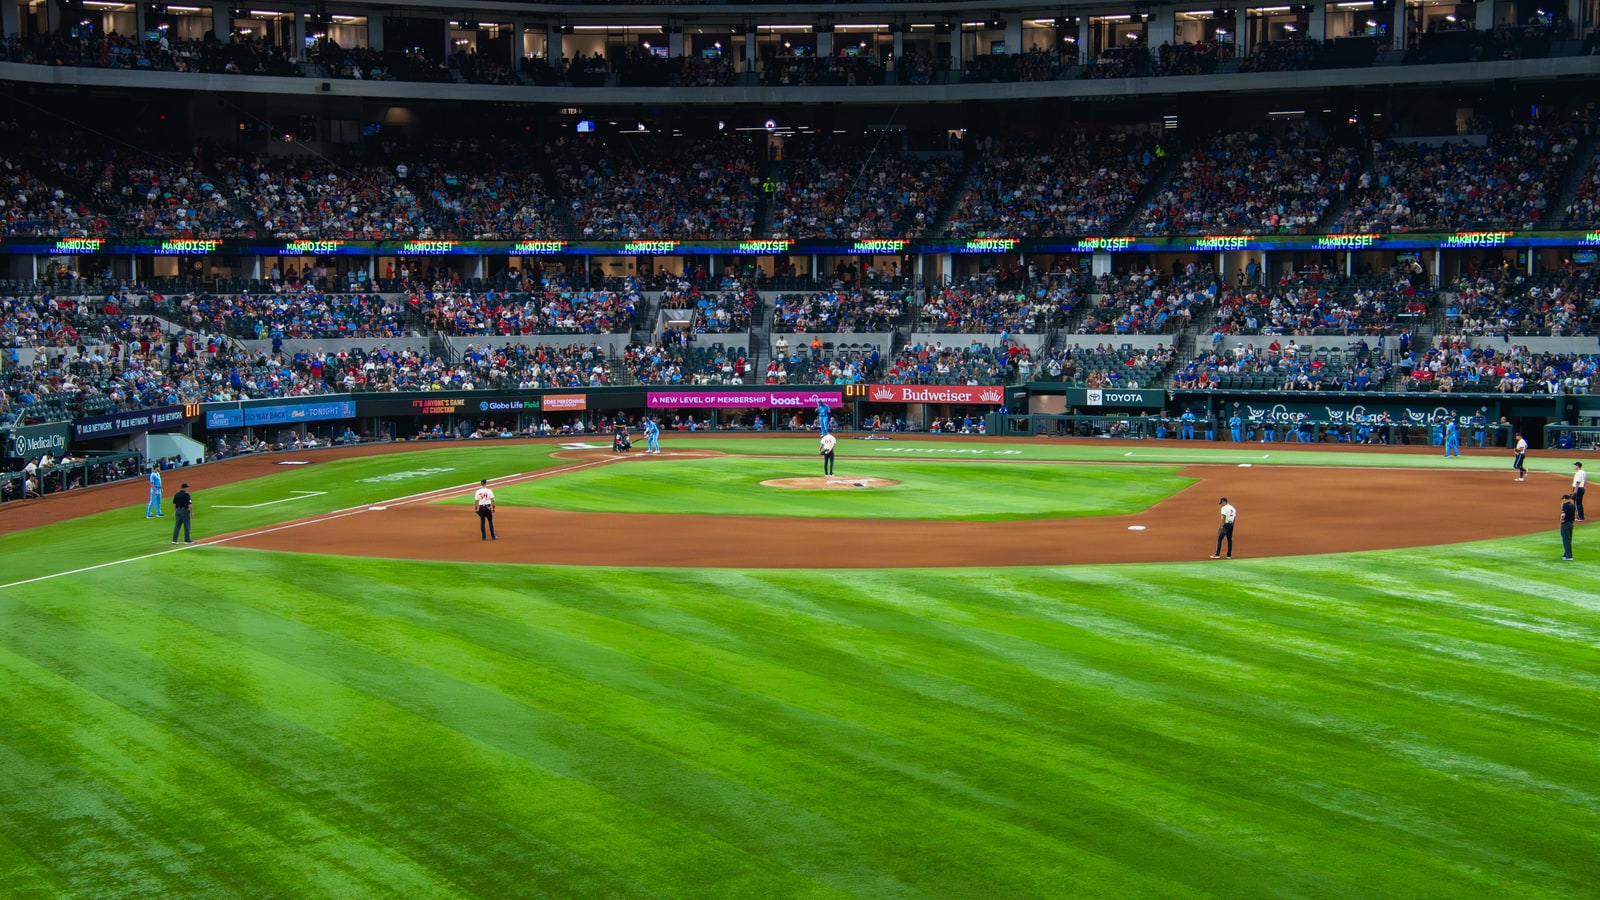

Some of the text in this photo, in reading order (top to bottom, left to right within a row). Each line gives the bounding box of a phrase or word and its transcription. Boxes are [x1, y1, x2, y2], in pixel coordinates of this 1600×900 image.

[770, 394, 800, 405] boost
[902, 388, 972, 402] Budweiser
[1105, 394, 1142, 402] TOYOTA
[524, 400, 540, 408] Field
[309, 406, 338, 416] TONIGHT
[121, 416, 149, 428] MLB NETWORK
[157, 412, 182, 423] MLB NETWORK
[83, 422, 112, 434] MLB NETWORK
[27, 434, 66, 450] Medical City
